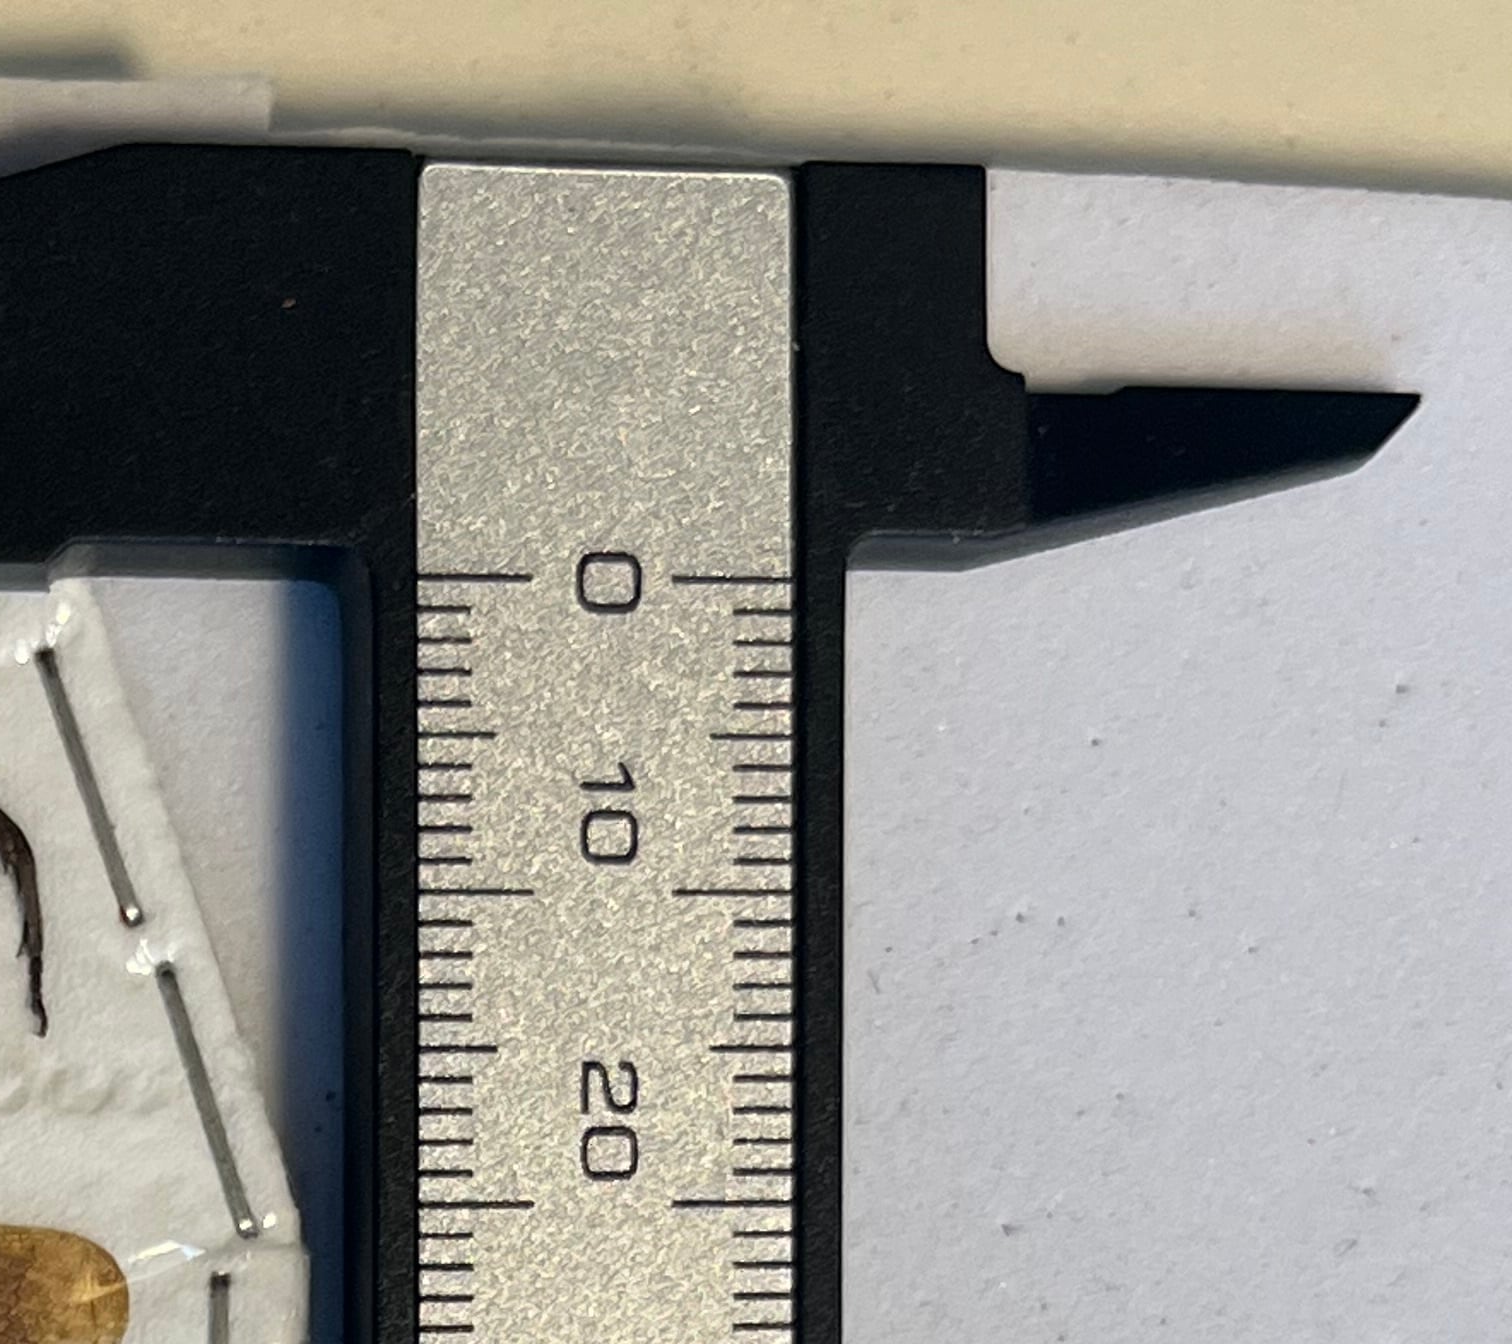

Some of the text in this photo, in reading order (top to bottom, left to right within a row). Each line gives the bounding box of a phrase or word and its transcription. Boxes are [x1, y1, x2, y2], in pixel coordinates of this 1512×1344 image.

[574, 548, 645, 617] 0
[577, 760, 641, 867] 10
[578, 1057, 642, 1183] 20
